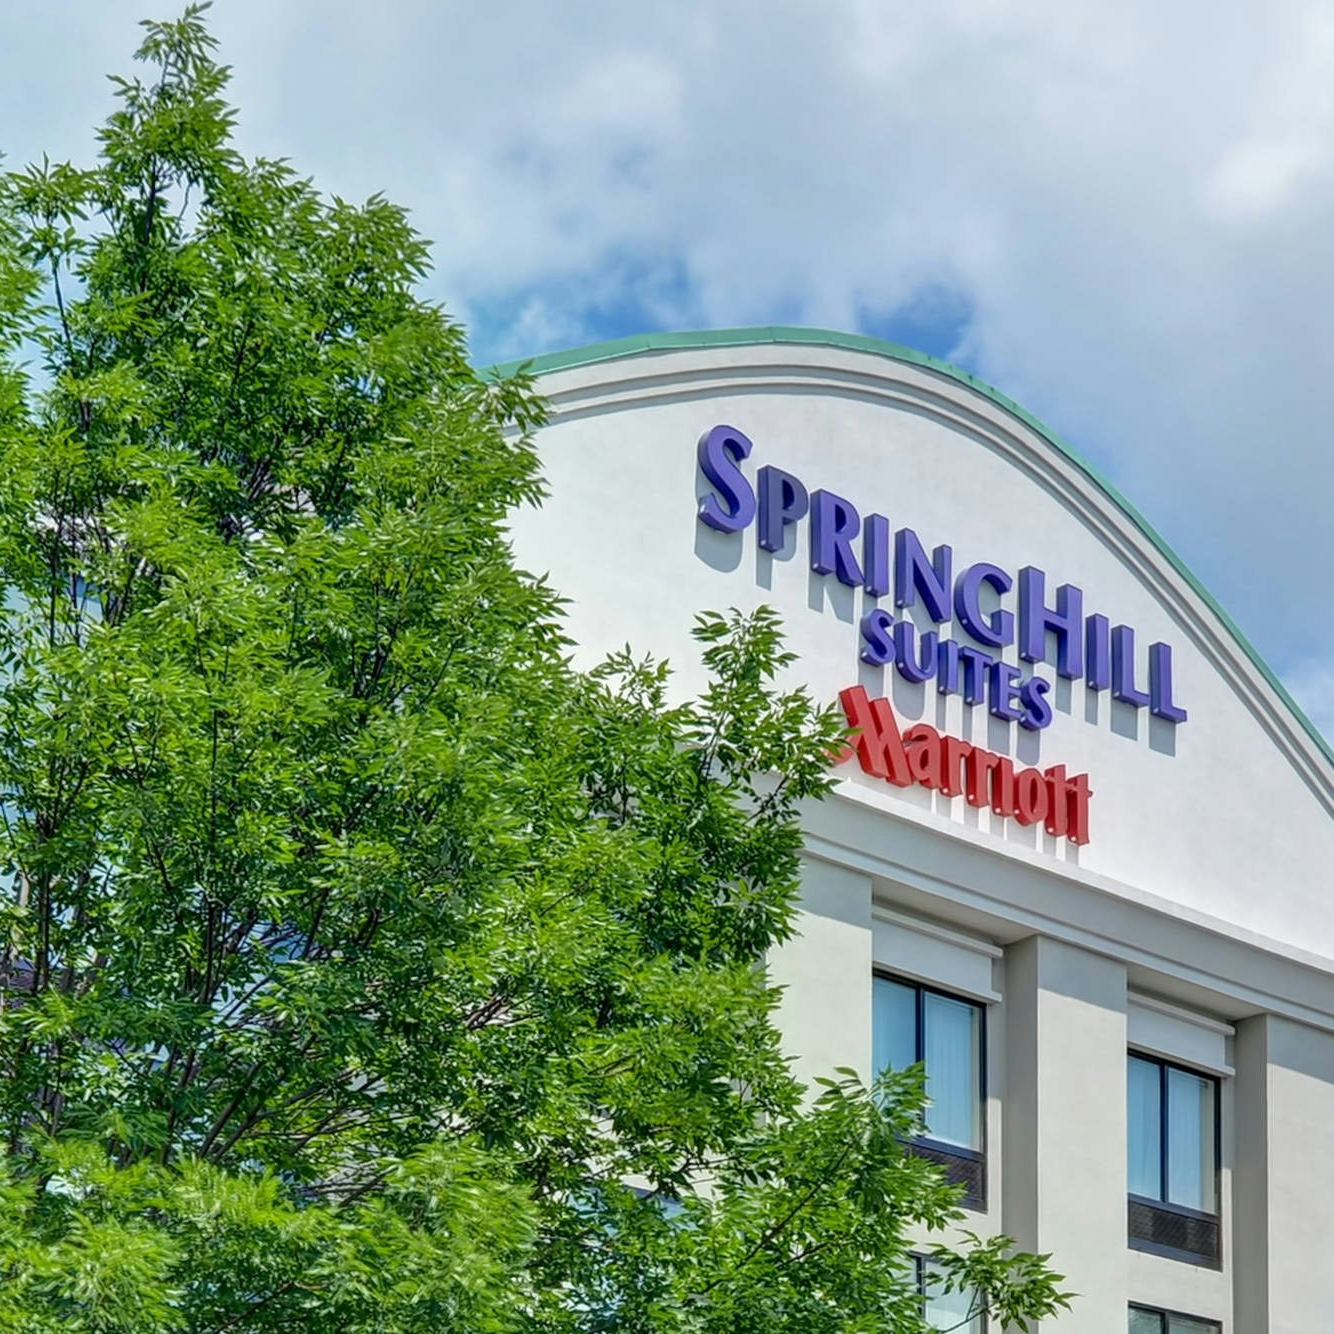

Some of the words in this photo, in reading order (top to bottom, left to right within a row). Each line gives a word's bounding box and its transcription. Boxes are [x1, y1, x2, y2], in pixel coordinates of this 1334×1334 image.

[697, 425, 1187, 724] SPRINGHILL
[860, 608, 1051, 731] SUITES
[826, 684, 1094, 846] Marriott
